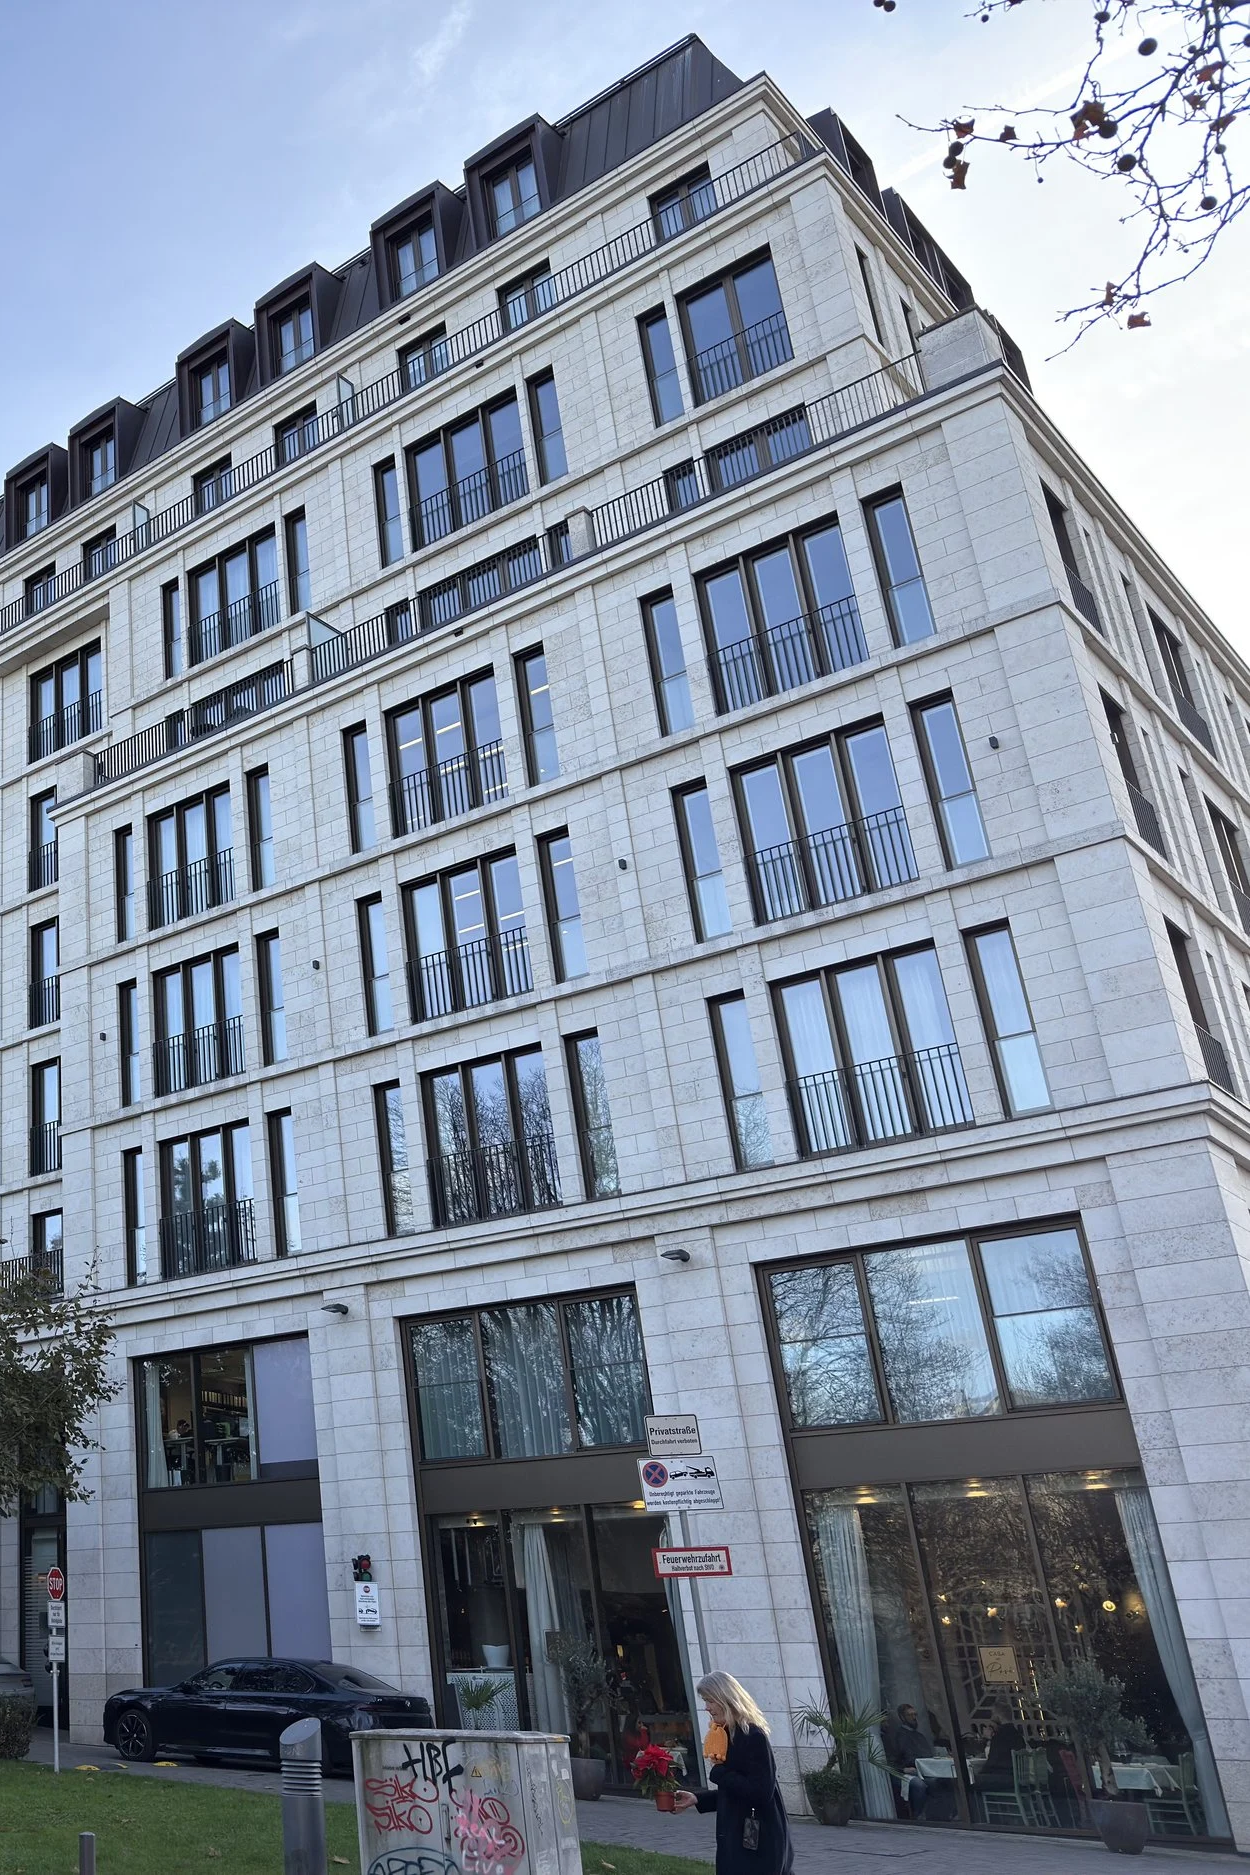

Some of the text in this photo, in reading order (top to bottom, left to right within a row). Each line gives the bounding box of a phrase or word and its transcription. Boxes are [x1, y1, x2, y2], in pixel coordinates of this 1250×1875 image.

[649, 1426, 696, 1436] Privatstraße
[662, 1552, 721, 1564] Feuerwehrzufahrt
[49, 1577, 62, 1590] STOP
